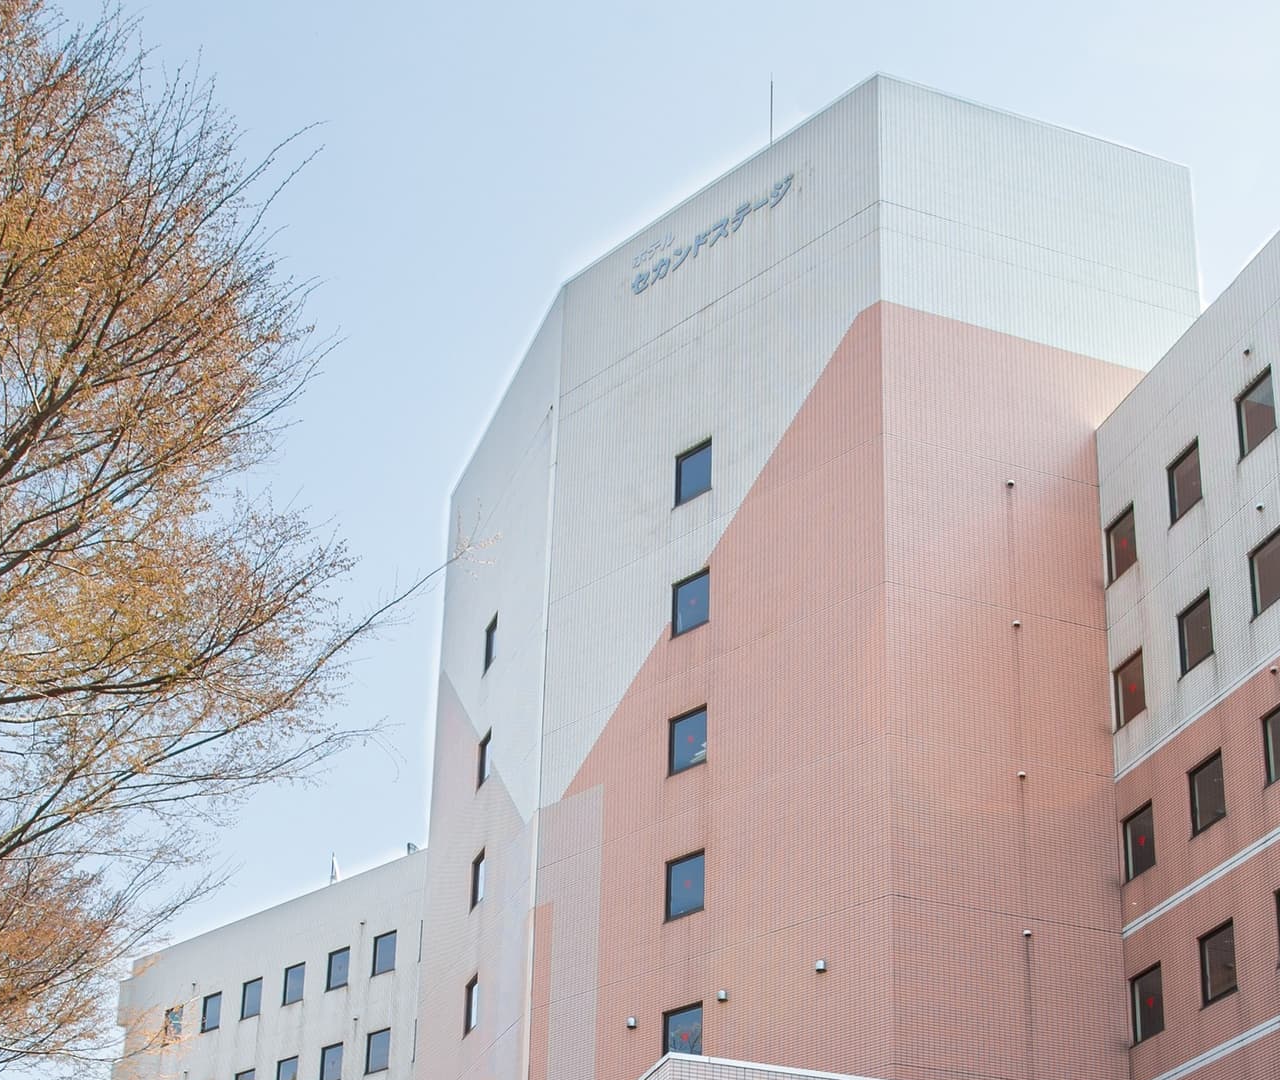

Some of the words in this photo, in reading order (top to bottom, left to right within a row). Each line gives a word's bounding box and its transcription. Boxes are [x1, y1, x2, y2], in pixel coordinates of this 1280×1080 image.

[631, 173, 794, 296] セカンドステージ
[632, 231, 675, 269] ホテル
